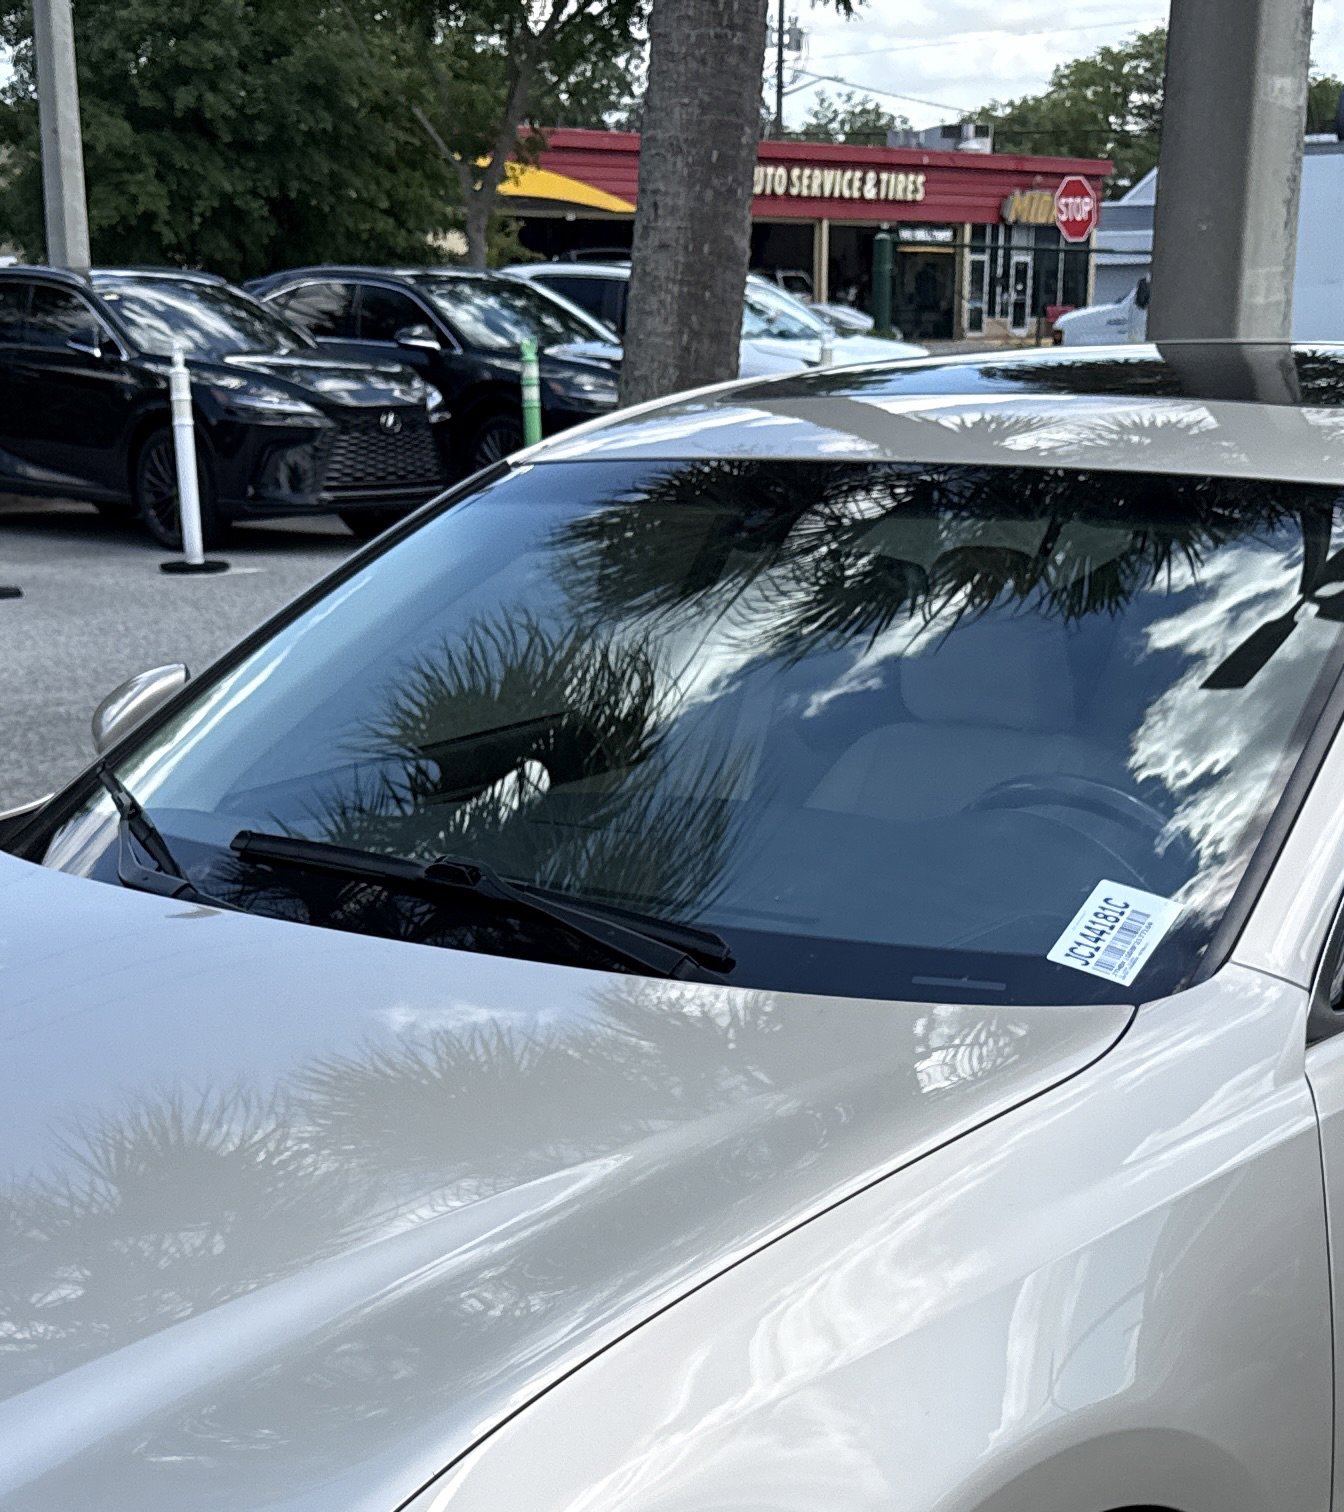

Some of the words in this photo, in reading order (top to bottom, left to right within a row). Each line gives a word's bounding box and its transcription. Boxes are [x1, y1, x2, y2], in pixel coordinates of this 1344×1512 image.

[753, 165, 788, 196] UTO
[788, 167, 863, 198] SERVICE
[863, 170, 878, 200] &
[878, 171, 927, 201] TIRES
[1058, 196, 1094, 222] STOP
[1063, 897, 1130, 967] JC144181C
